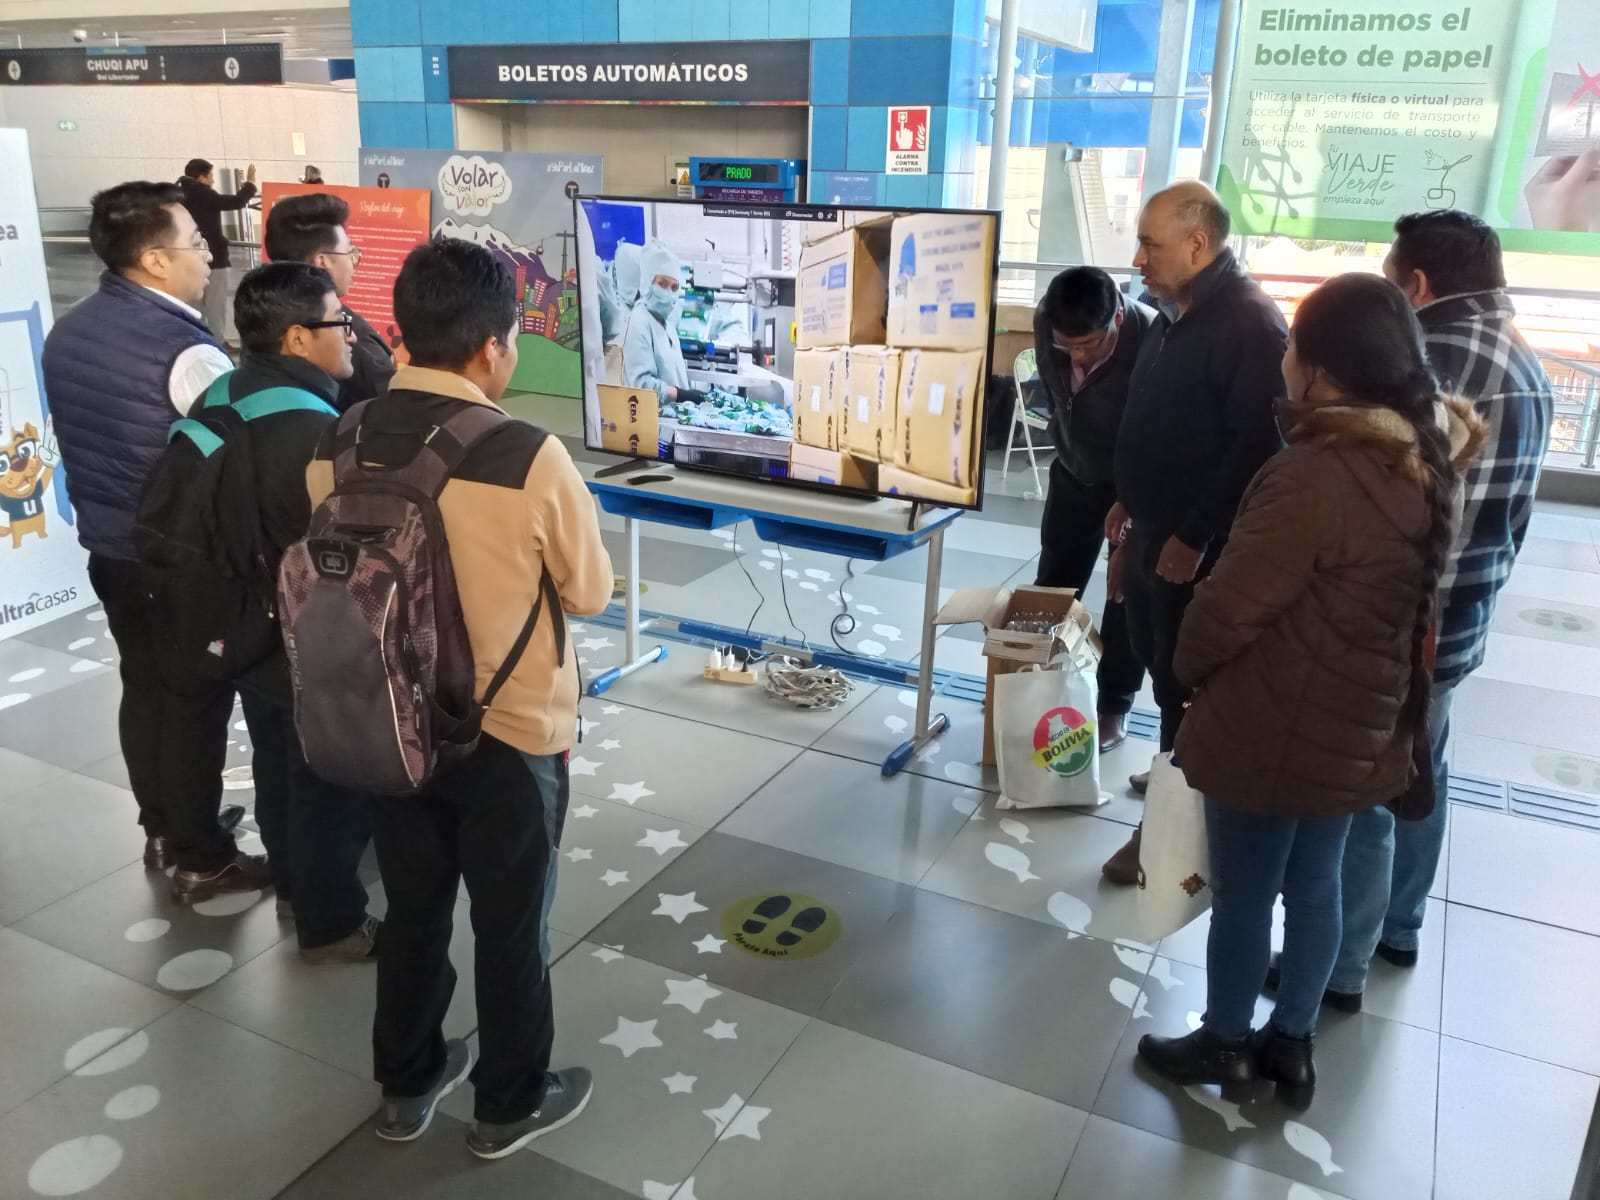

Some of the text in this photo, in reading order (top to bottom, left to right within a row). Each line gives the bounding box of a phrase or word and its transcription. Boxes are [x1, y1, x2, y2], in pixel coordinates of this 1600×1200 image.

[1259, 8, 1471, 32] Eliminamos el
[86, 59, 123, 71] CHUQI
[125, 59, 149, 71] APU
[1254, 44, 1493, 73] boleto de papel
[498, 62, 749, 82] BOLETOS AUTOMÁTICOS
[1249, 90, 1484, 109] Utiliza la tarjeta física o virtual para
[1246, 107, 1481, 124] acceder al servicio de transporte
[1244, 123, 1265, 136] por
[1315, 123, 1398, 137] Mantenemos
[1405, 126, 1417, 137] el
[1424, 129, 1462, 138] costo
[1469, 131, 1478, 142] y
[726, 167, 752, 179] PRADO
[1327, 152, 1397, 174] VIAJE
[450, 163, 499, 188] Volar
[1322, 164, 1395, 198] Verde
[1042, 727, 1090, 762] BOLIVIA
